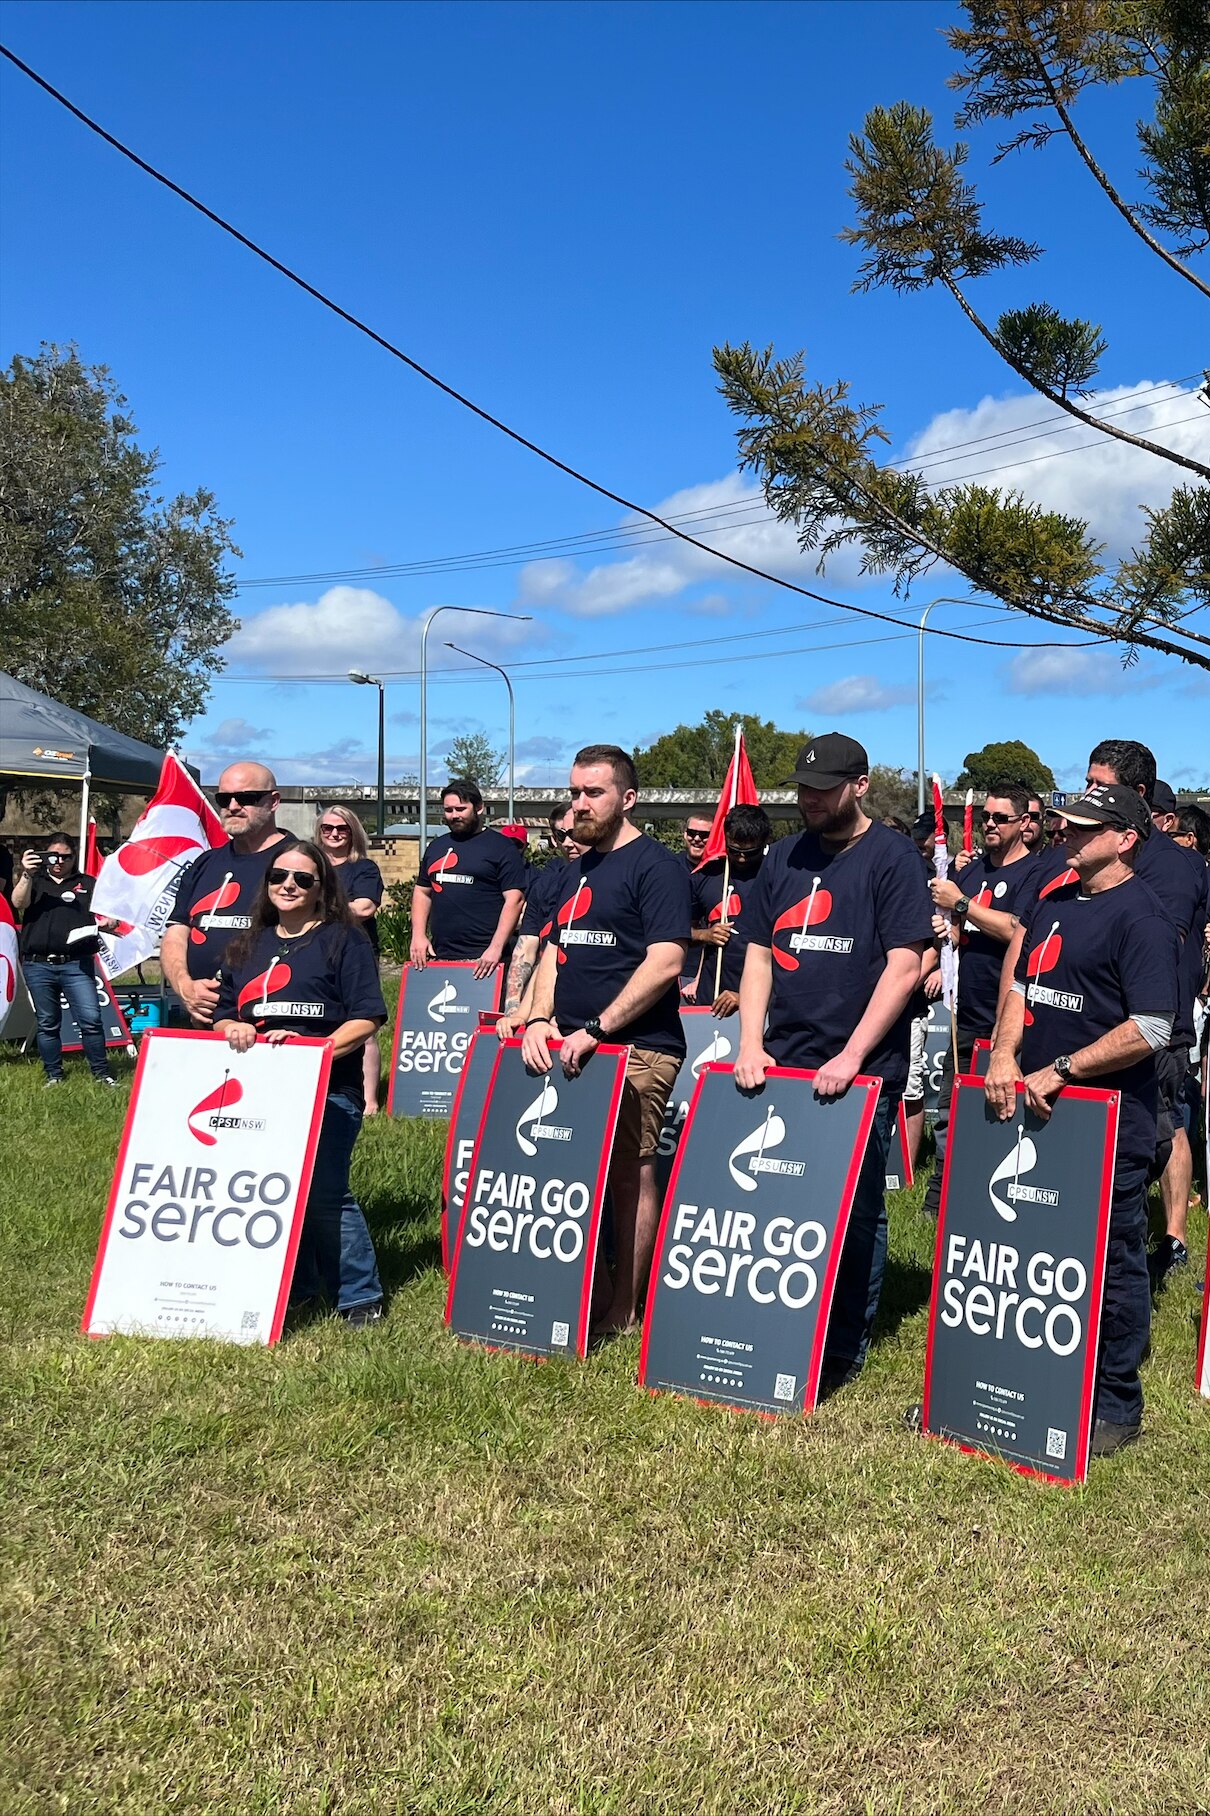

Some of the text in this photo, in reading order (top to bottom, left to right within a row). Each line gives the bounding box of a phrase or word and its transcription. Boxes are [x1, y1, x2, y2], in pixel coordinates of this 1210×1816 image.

[201, 916, 251, 928] CPSUNS
[561, 931, 614, 944] CPSUNSW
[793, 936, 851, 952] CPSUNSW
[1028, 986, 1080, 1009] CPSUNSW
[254, 1004, 322, 1016] CPSUNSW
[401, 1030, 474, 1051] FAIR G
[398, 1050, 467, 1074] serc
[210, 1116, 264, 1129] CPSUNSW
[532, 1126, 571, 1139] CPSUNSW
[751, 1159, 803, 1175] CPSUNSW
[129, 1163, 291, 1206] FAIR GO
[474, 1169, 537, 1211] FAIR
[541, 1180, 589, 1219] GO
[1009, 1186, 1056, 1204] CPSUNSW
[673, 1204, 827, 1261] FAIR GO
[946, 1234, 1087, 1302] FAIR GO
